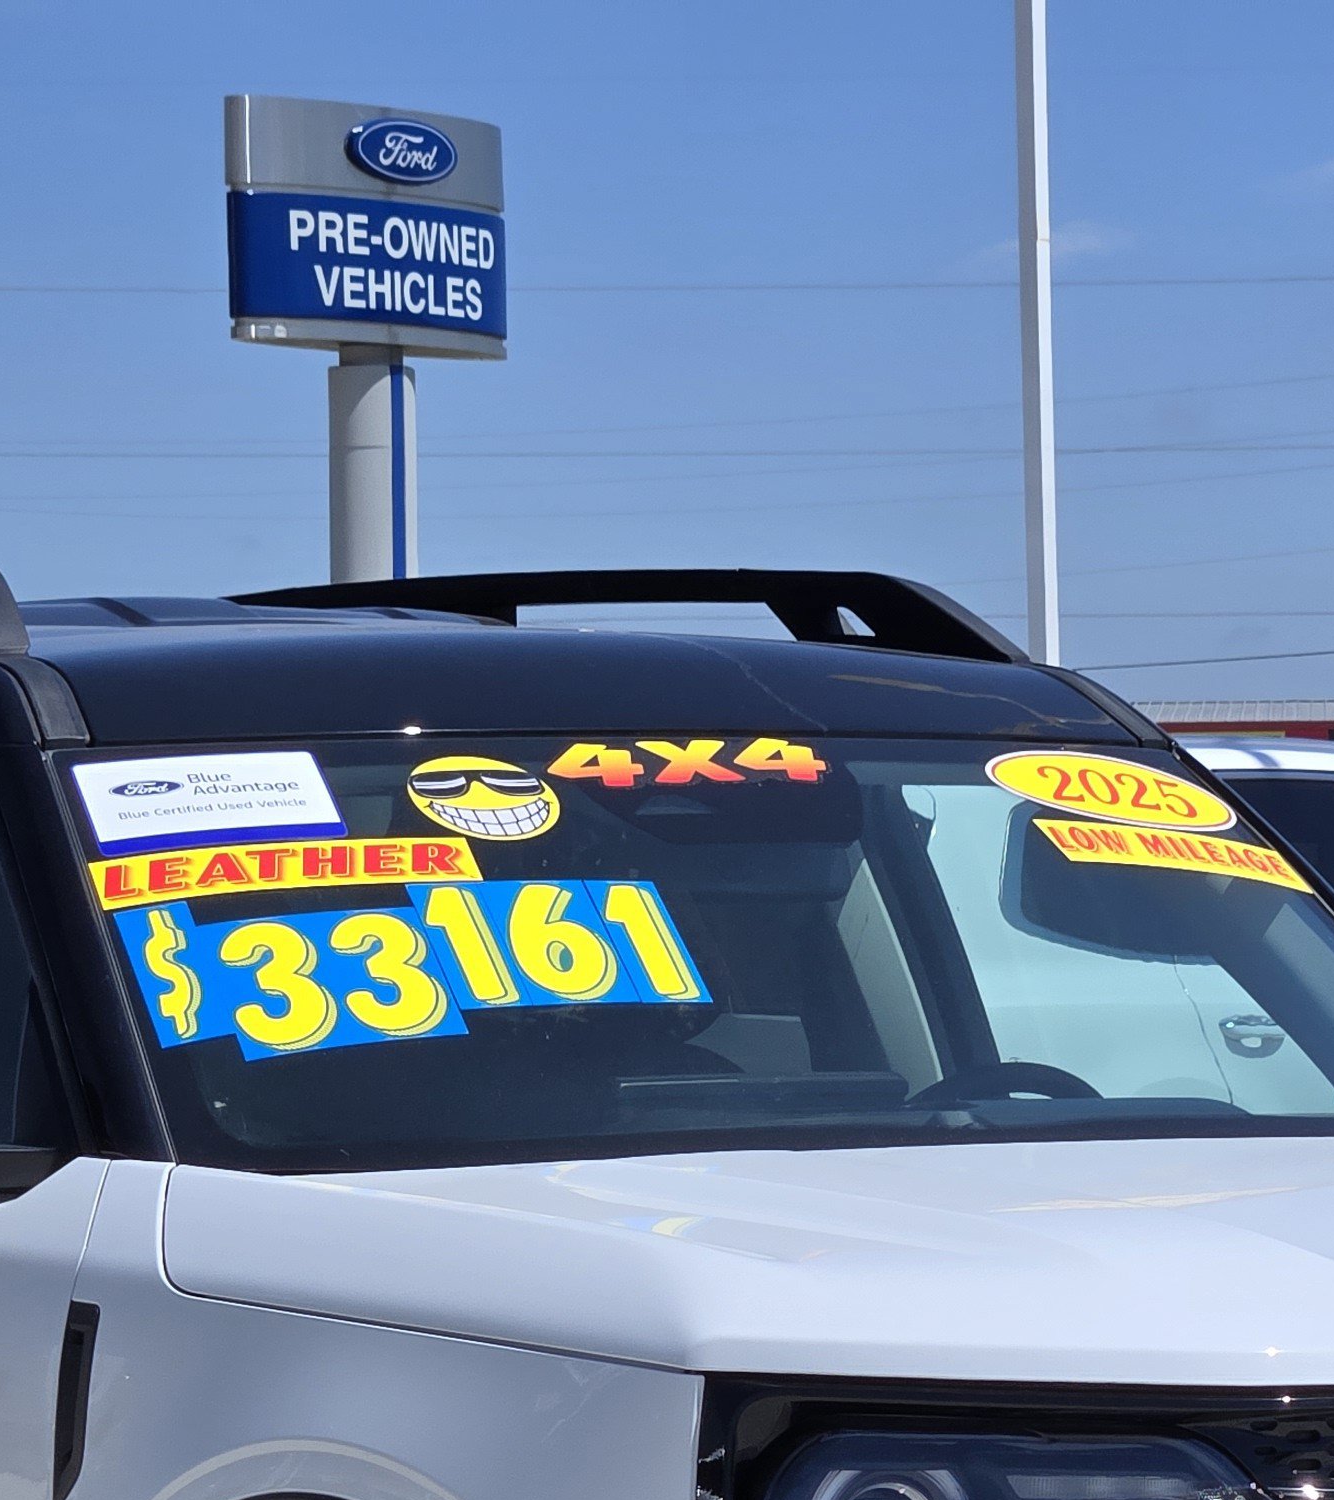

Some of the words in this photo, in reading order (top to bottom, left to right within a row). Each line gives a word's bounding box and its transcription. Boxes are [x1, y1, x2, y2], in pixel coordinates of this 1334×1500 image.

[379, 131, 437, 171] Ford
[288, 209, 495, 269] PRE-OWNED
[314, 265, 483, 321] VEHICLES
[187, 772, 232, 784] Blue
[193, 777, 300, 797] Advantage
[547, 737, 828, 788] 4X4
[118, 809, 150, 821] Blue
[154, 803, 214, 818] Certified
[217, 799, 253, 812] Used
[256, 797, 307, 809] Vehicle
[124, 781, 169, 797] Ford
[1037, 765, 1198, 819] 2025
[103, 842, 467, 900] LEATHER
[1047, 826, 1130, 855] LOW
[1136, 832, 1297, 882] MILEAGE
